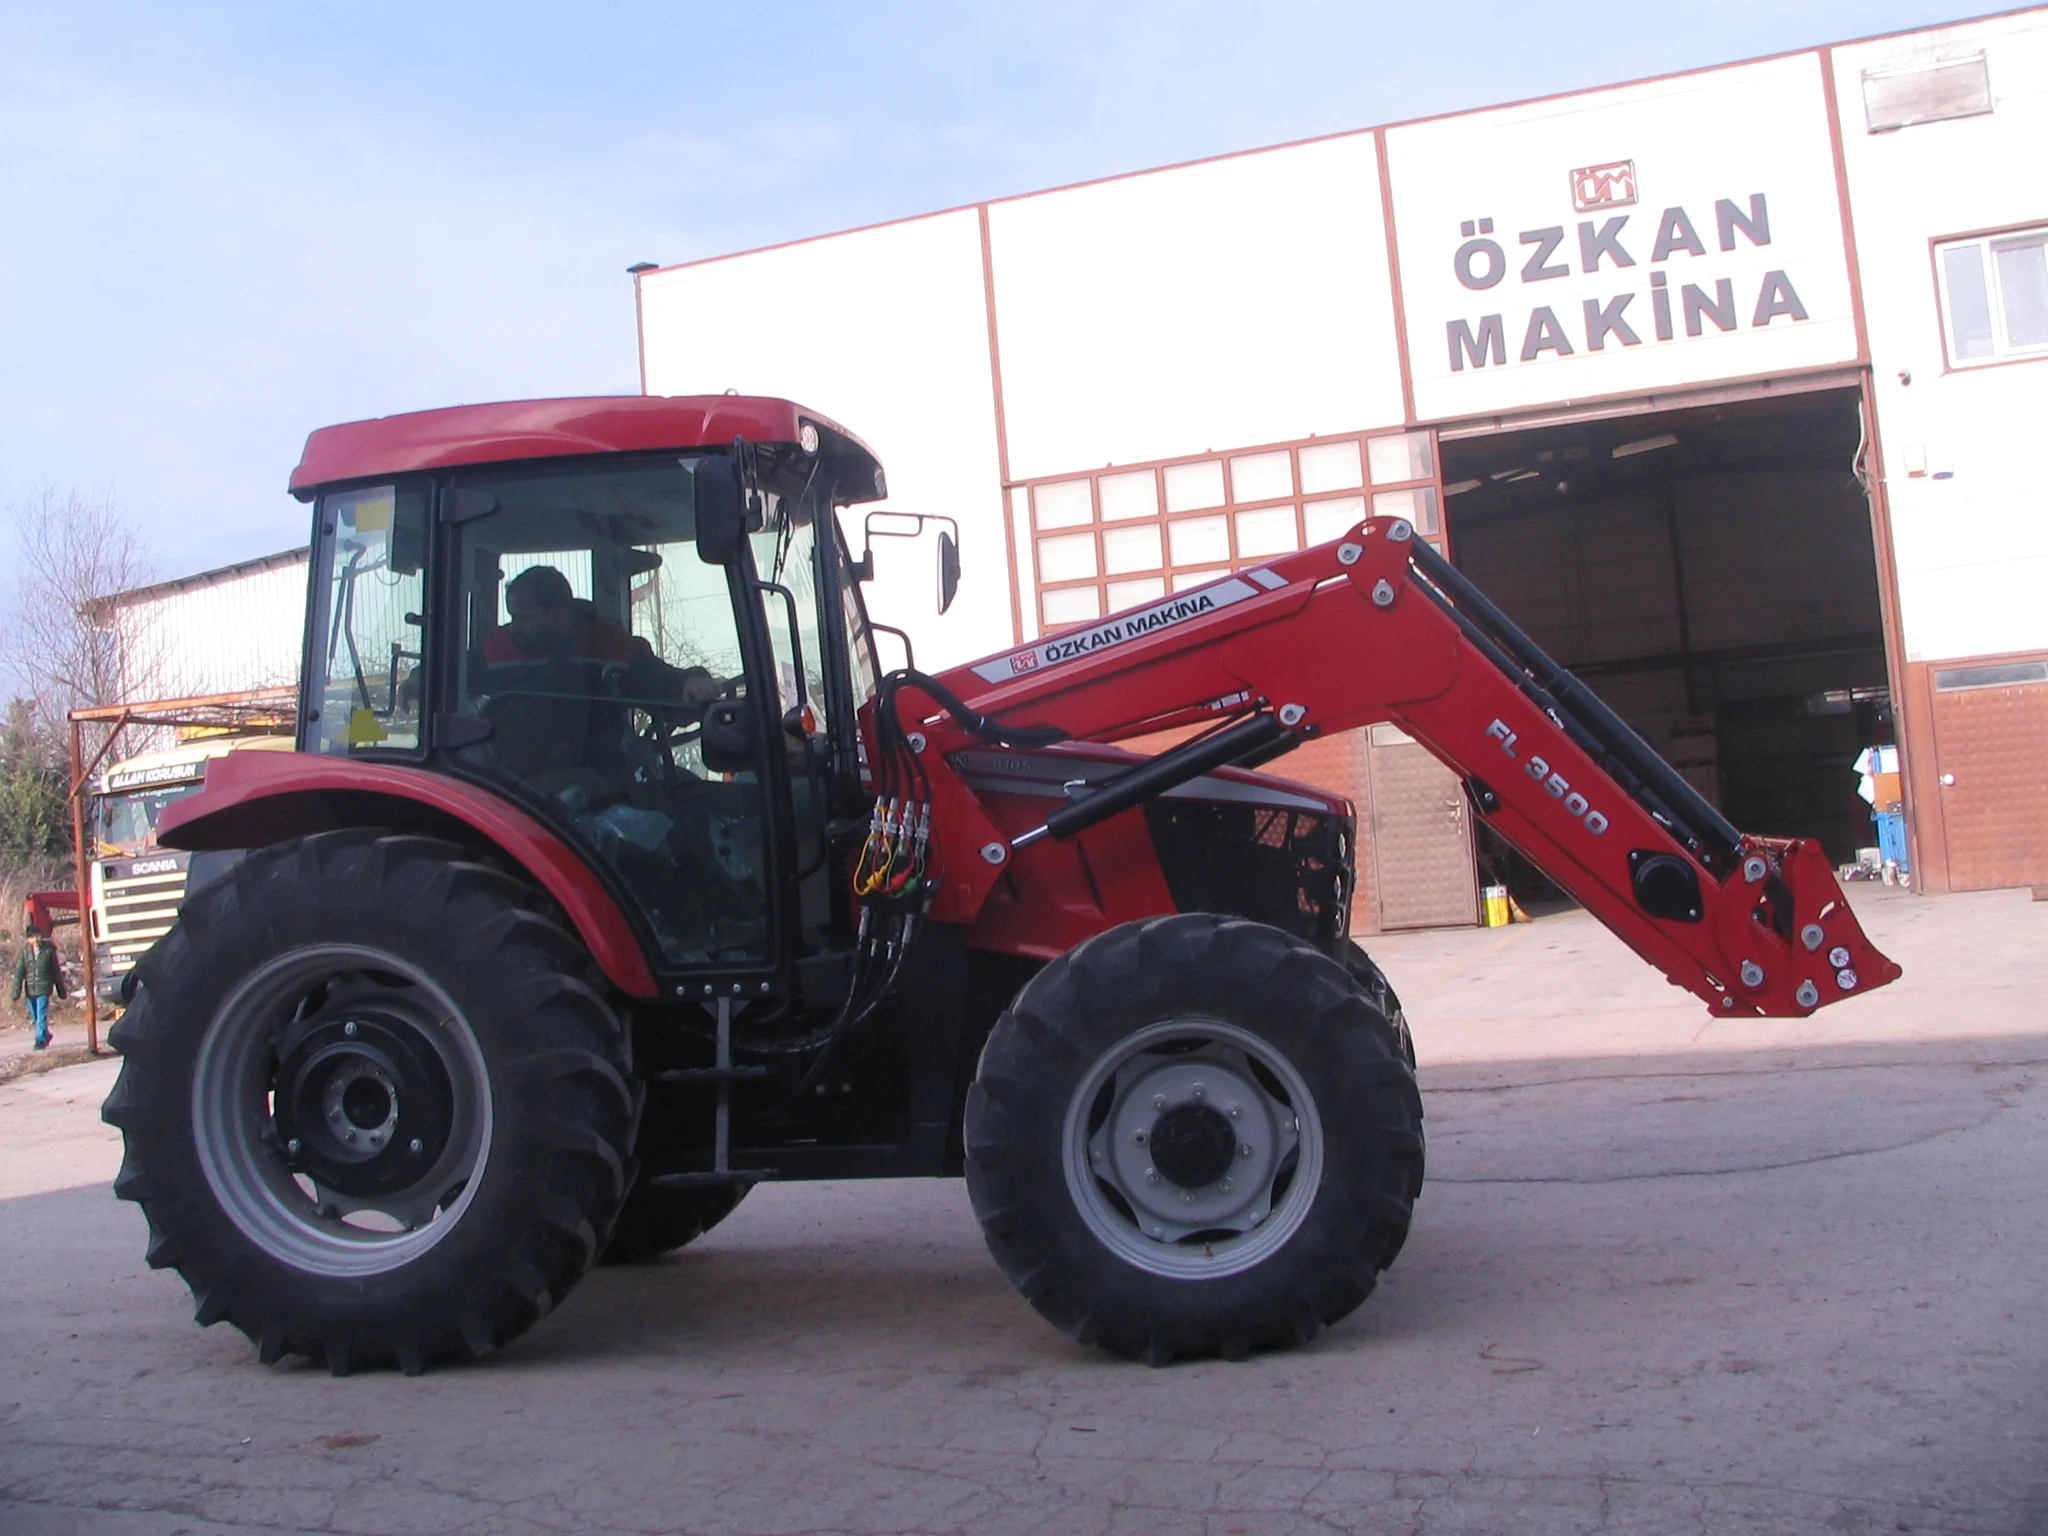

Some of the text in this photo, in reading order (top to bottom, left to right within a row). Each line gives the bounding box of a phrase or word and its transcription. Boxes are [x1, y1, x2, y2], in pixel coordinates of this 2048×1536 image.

[1454, 193, 1771, 290] ÖZKAN
[1446, 269, 1809, 371] MAKİNA
[1045, 595, 1214, 662] ÖZKAN MAKİNA
[112, 769, 145, 788] ALLAH
[1485, 718, 1610, 836] FL 3500
[132, 859, 178, 875] SCANIA
